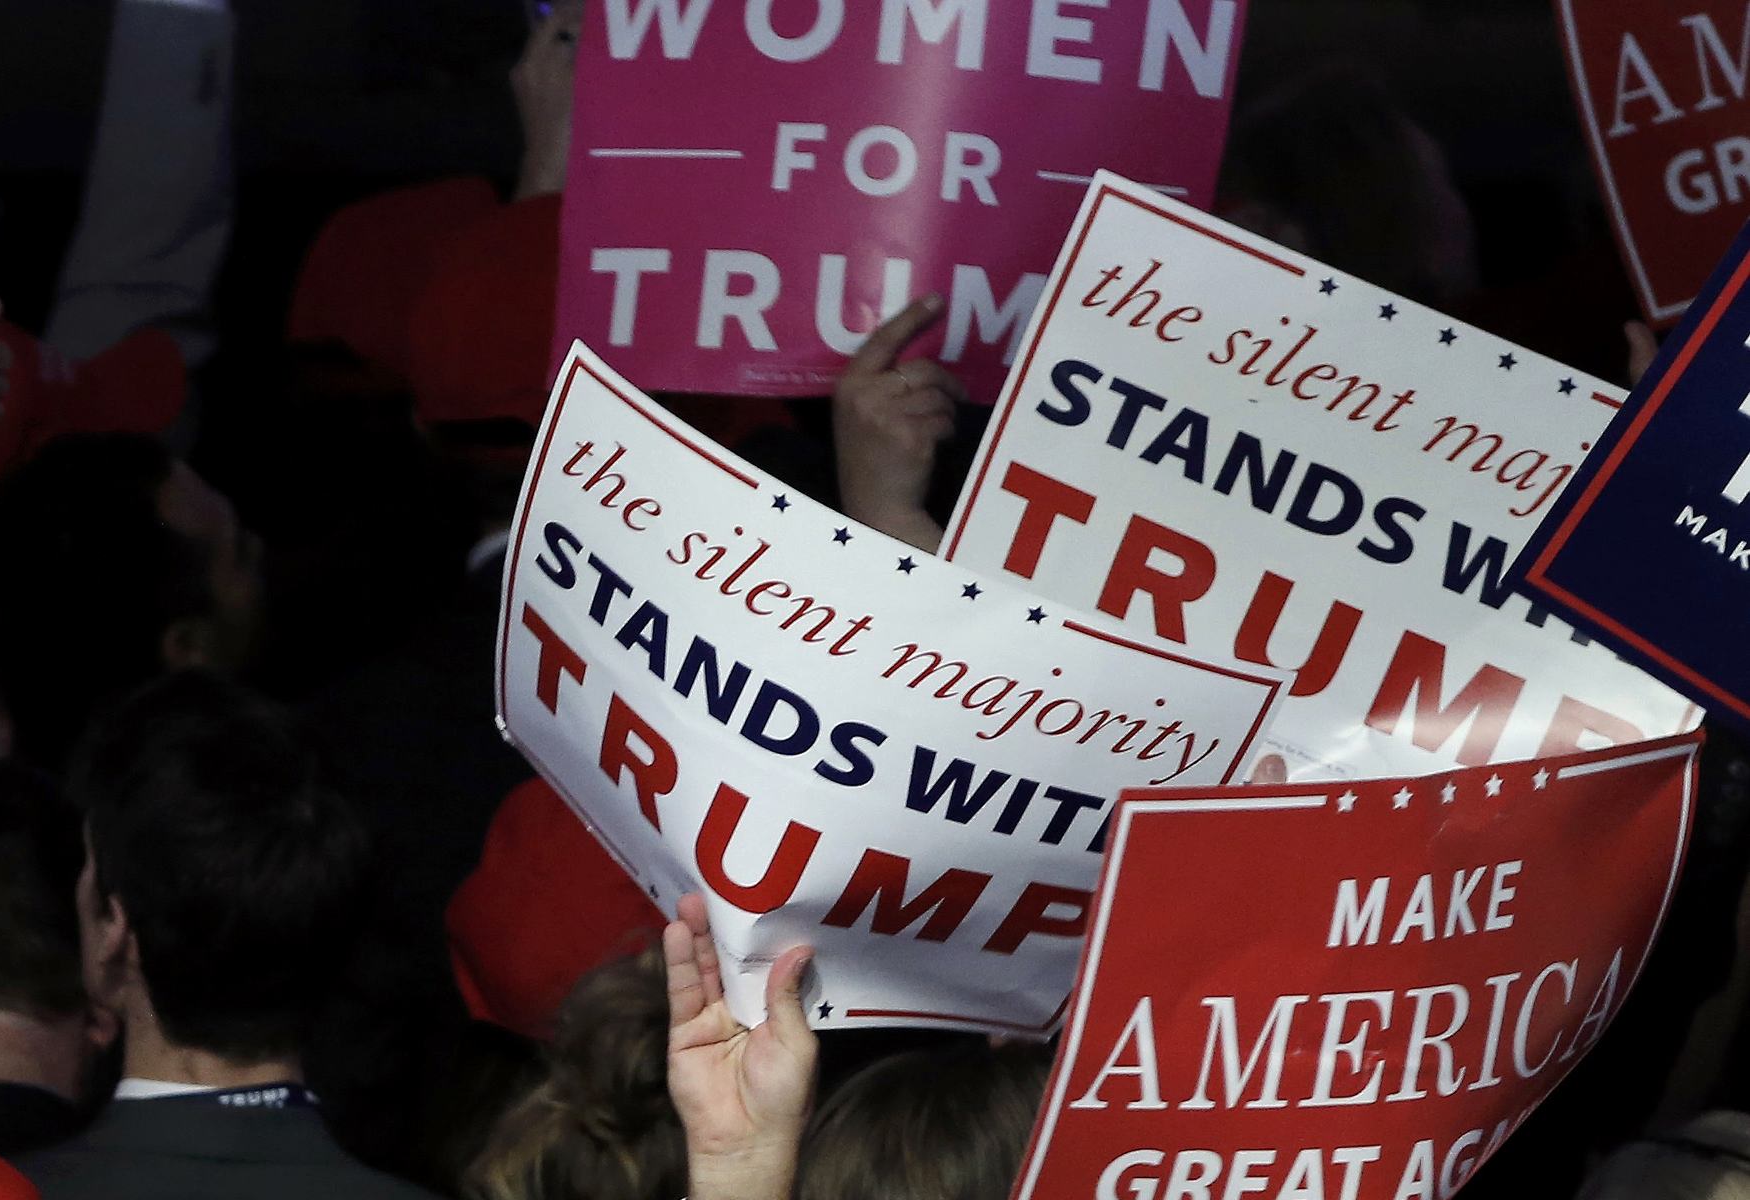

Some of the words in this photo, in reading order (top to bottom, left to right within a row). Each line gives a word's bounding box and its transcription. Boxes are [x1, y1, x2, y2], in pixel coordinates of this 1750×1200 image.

[601, 0, 1237, 99] WOMEN
[770, 122, 1003, 207] FOR
[1081, 259, 1204, 342] the
[1207, 316, 1417, 432] silent
[1036, 360, 1427, 564] STANDS
[535, 521, 888, 786] STANDS
[562, 440, 662, 531] the
[667, 526, 873, 656] silent
[881, 642, 1219, 785] majority
[522, 602, 1095, 956] TRUMP
[1326, 860, 1522, 948] MAKE
[1070, 946, 1624, 1110] AMERICA
